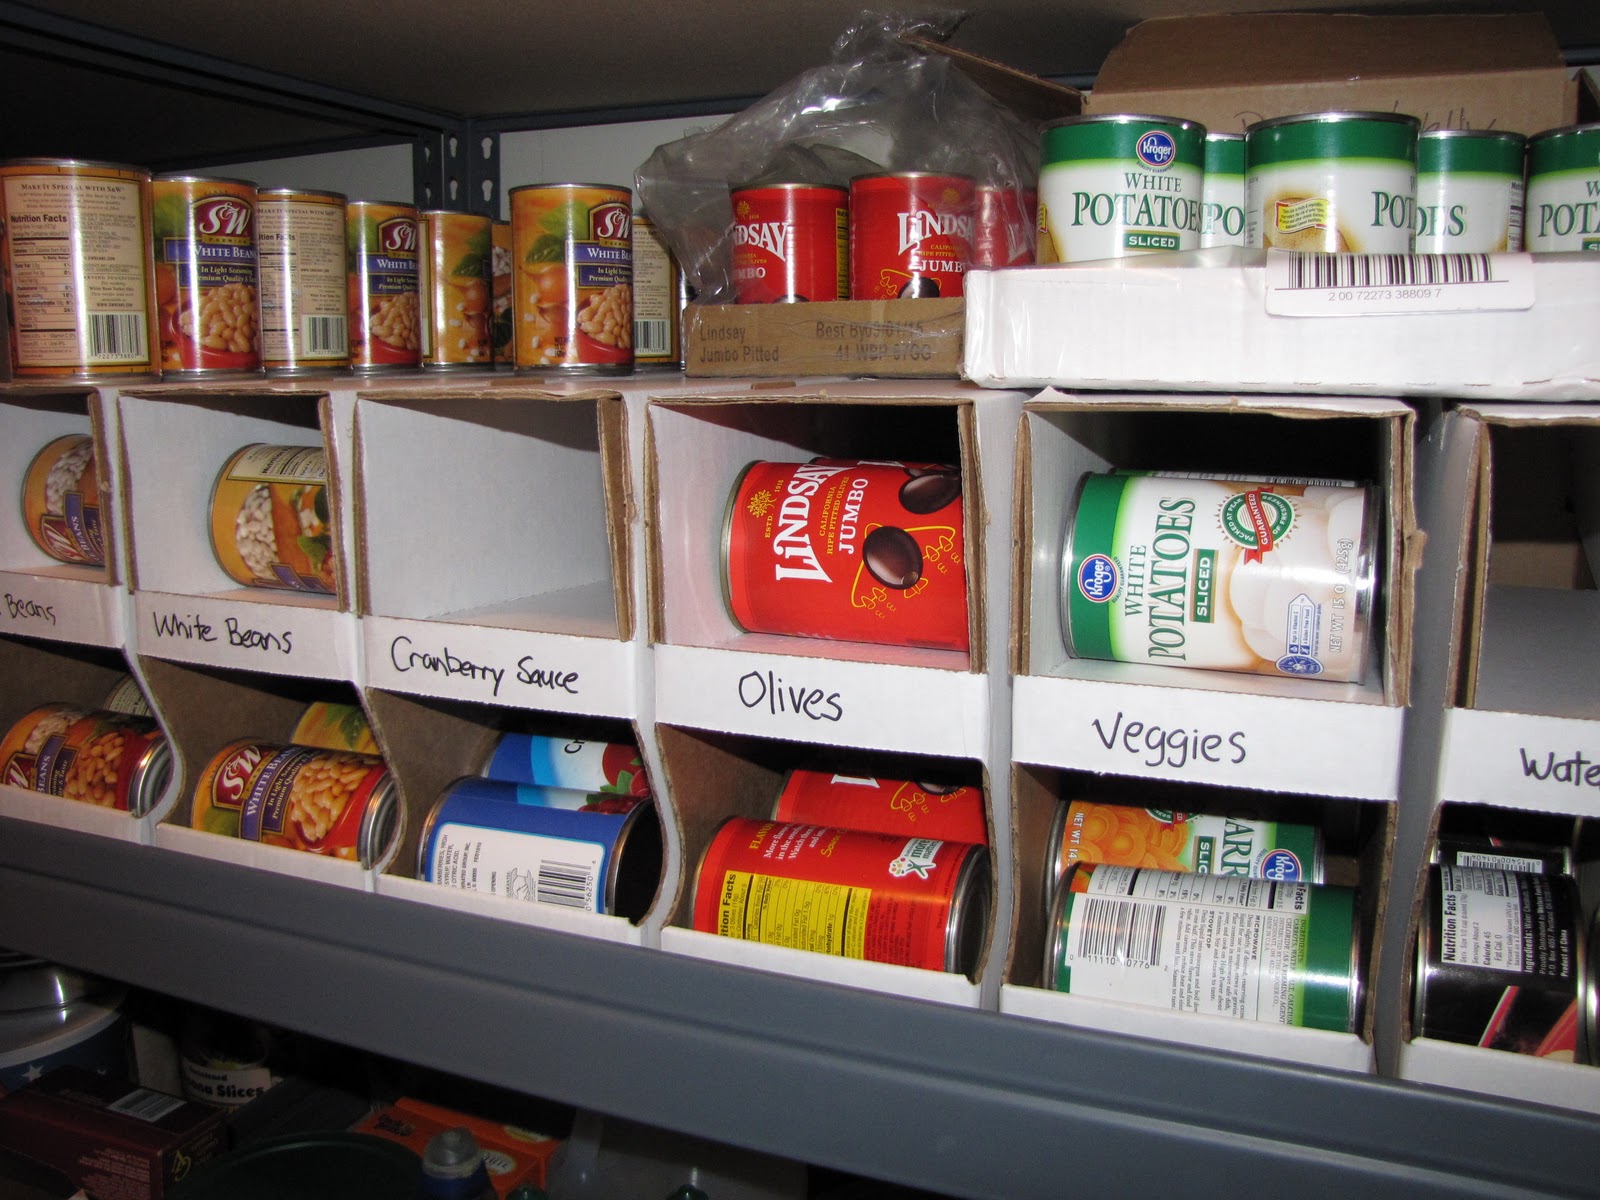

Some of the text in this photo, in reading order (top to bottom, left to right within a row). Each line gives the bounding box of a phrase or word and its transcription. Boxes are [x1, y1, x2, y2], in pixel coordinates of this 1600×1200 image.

[1143, 137, 1172, 162] Kroger
[1124, 172, 1182, 192] WHITE
[10, 213, 68, 224] Nutrition Facts
[587, 247, 621, 259] WHITE
[1128, 236, 1176, 249] SLICED
[210, 266, 228, 275] Light
[376, 258, 409, 270] WHITE
[604, 267, 618, 275] Light
[919, 260, 964, 273] JUMB
[1328, 288, 1442, 302] 2 00 72273 38809 7
[700, 324, 746, 343] Lindsay
[816, 322, 844, 337] Best
[700, 346, 779, 363] Jumbo Pitted
[819, 486, 837, 537] CALIFORNIA
[826, 475, 850, 556] RIPE PITTED OLIVES
[838, 478, 869, 555] JUMBO
[1225, 498, 1254, 541] PACKED AT PEAK
[1245, 492, 1270, 545] GUARANTEED
[1261, 494, 1288, 534] OF FRESHNESS
[764, 512, 775, 539] ESTD.
[1084, 559, 1111, 596] Kroger
[1124, 544, 1146, 618] WHITE
[1147, 495, 1197, 662] POTATOES
[1196, 556, 1211, 618] SLICED
[1329, 537, 1353, 652] NET WT 15 (425g)
[4, 594, 56, 626] Beans
[152, 612, 293, 655] White Beans
[391, 636, 579, 697] Cranberry Sauce
[738, 670, 843, 722] Olives
[1092, 711, 1247, 769] Veggies
[246, 775, 271, 817] WHITE
[266, 777, 285, 808] In Light
[272, 789, 287, 820] Premium
[1073, 812, 1084, 845] NET WT
[445, 843, 454, 864] WATER,
[763, 836, 780, 859] More
[776, 839, 791, 860] in the
[788, 837, 802, 859] Watch
[910, 839, 931, 858] more
[724, 873, 737, 906] Facts
[1293, 887, 1305, 910] Facts
[1205, 909, 1214, 948] STOVETOP
[1250, 914, 1260, 960] MICROWAVE
[1283, 917, 1293, 950] CHLORIDE
[1443, 893, 1456, 961] Nutrition Facts
[1559, 929, 1567, 944] China
[1296, 919, 1306, 963] INGREDIENTS:
[1483, 940, 1491, 965] Calories
[1523, 913, 1534, 973] Ingredients: Water
[1218, 959, 1226, 975] High
[1494, 951, 1502, 961] Fat
[1538, 951, 1547, 974] Proudly
[1560, 953, 1568, 977] Product
[1171, 968, 1180, 987] Season
[1285, 918, 1299, 1024] CARROTS, CALCIUM
[1277, 1000, 1287, 1023] AGENT
[217, 1083, 264, 1099] Slices
